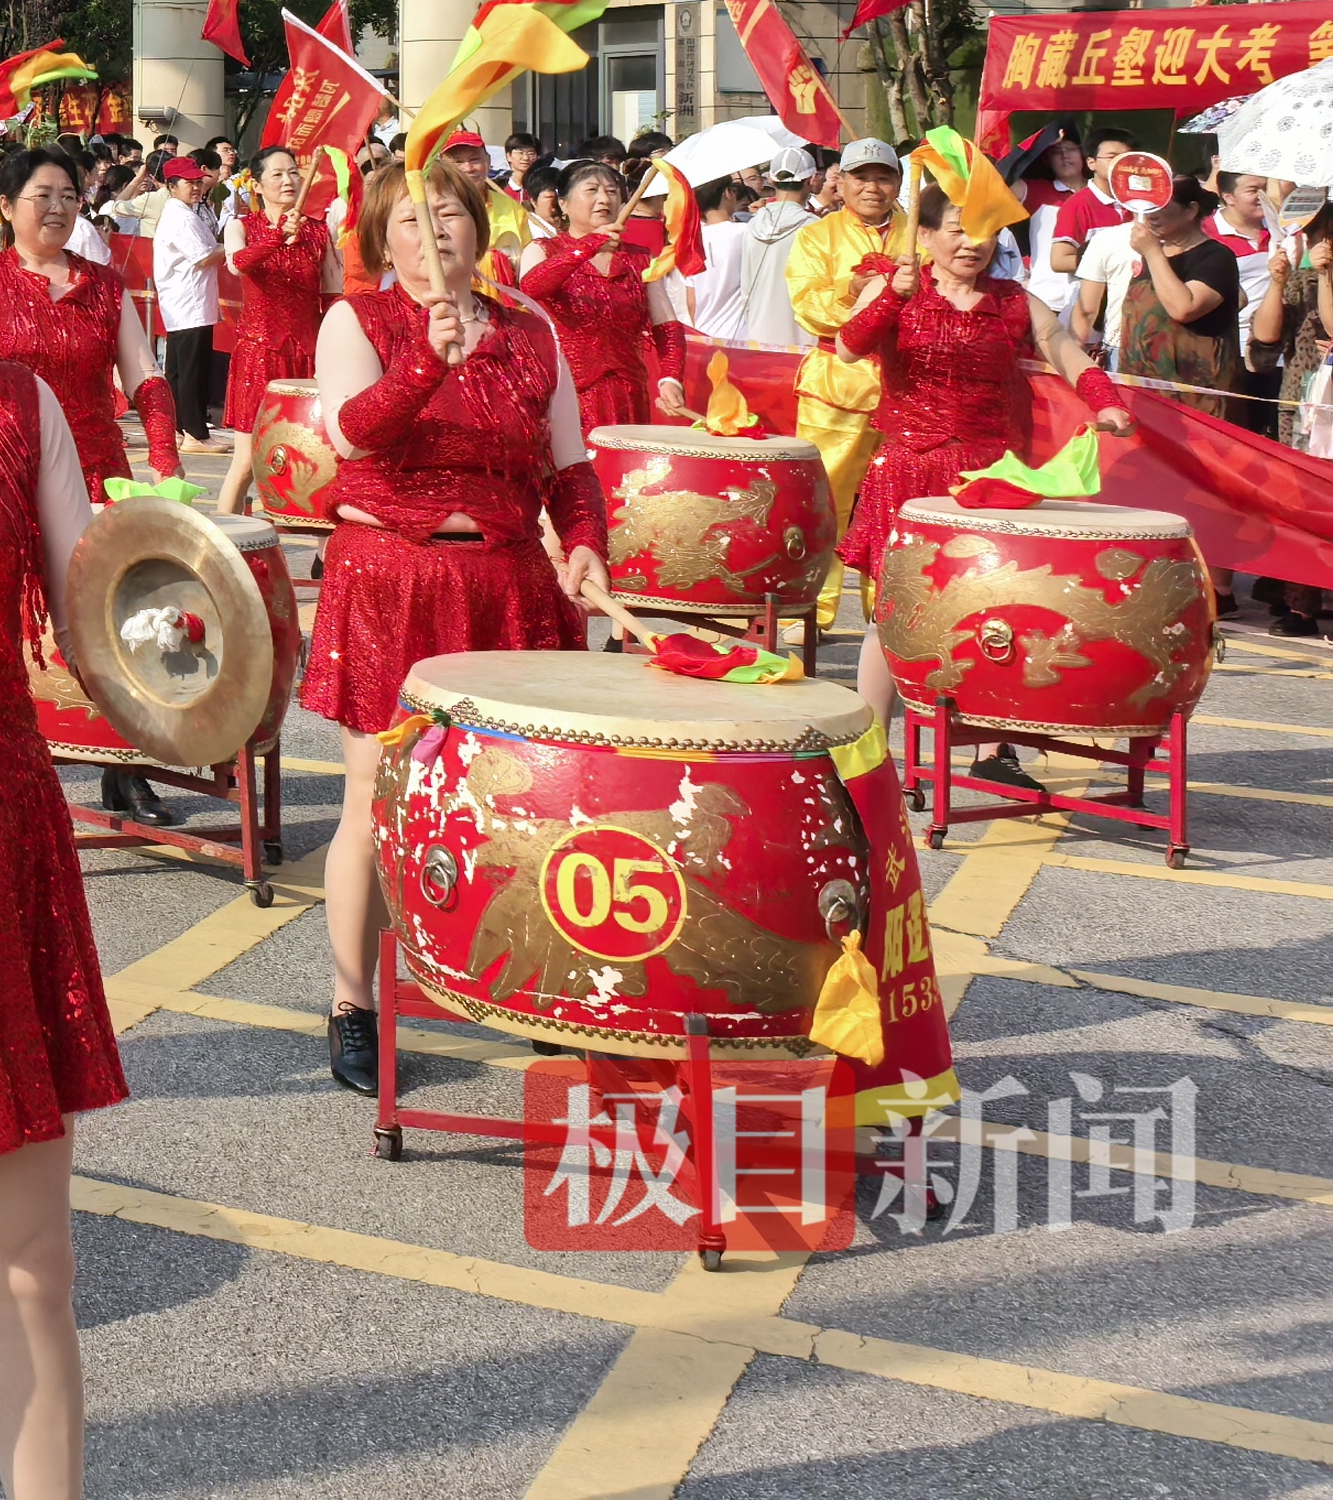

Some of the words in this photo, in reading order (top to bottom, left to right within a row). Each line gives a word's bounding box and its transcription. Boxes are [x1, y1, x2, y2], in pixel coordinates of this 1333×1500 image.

[1001, 21, 1282, 90] 胸藏丘壑迎大考
[557, 853, 669, 934] 05
